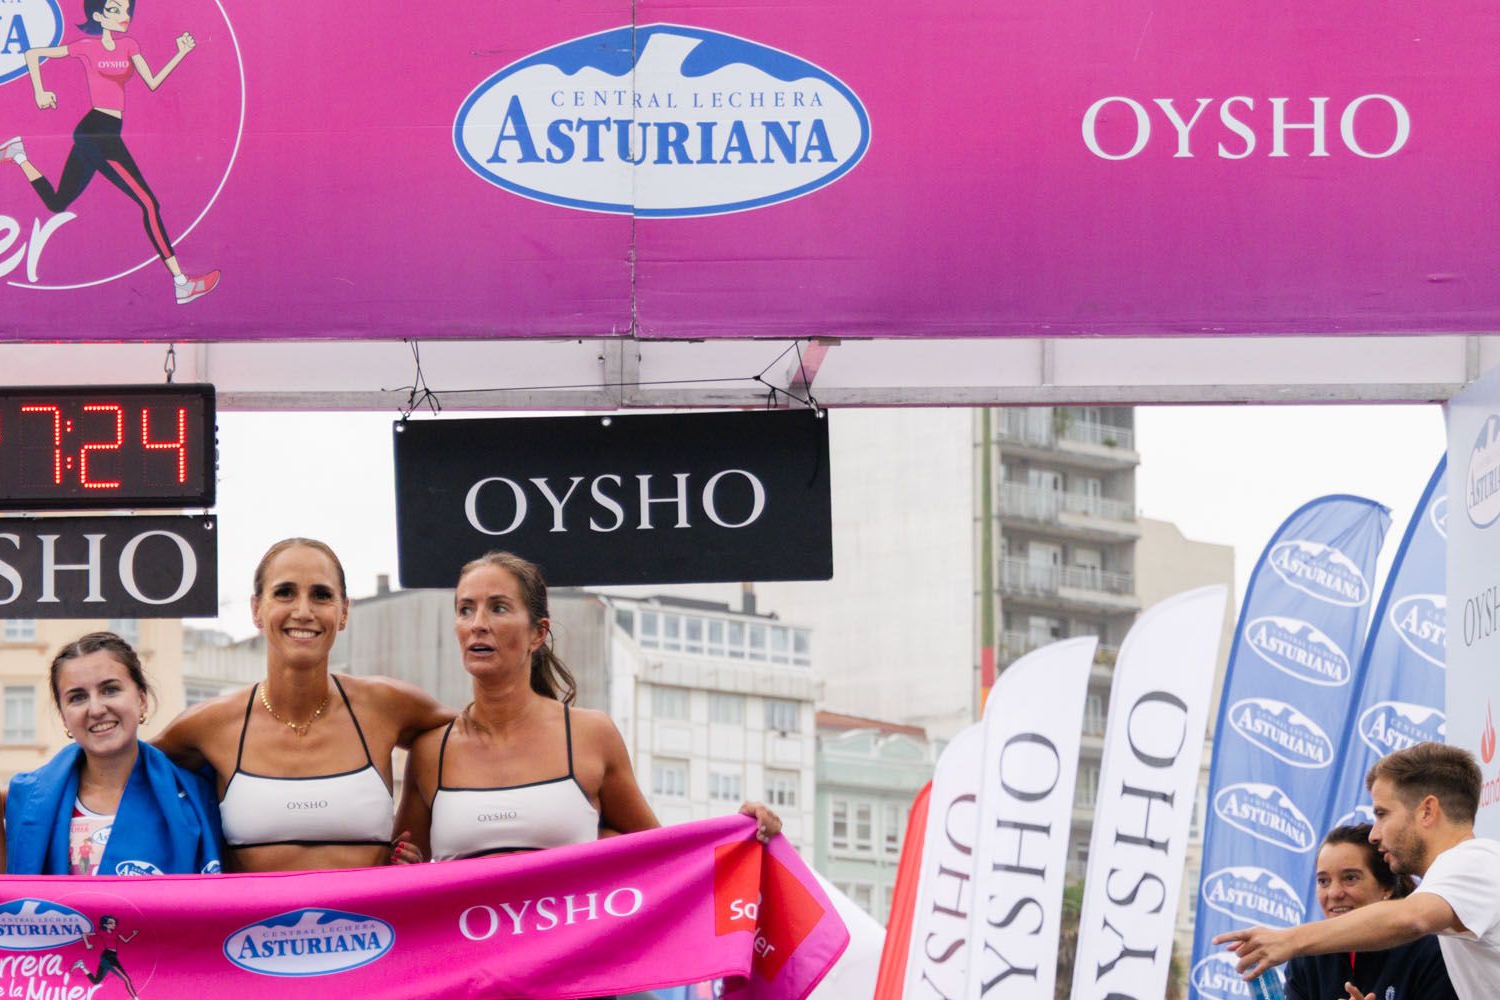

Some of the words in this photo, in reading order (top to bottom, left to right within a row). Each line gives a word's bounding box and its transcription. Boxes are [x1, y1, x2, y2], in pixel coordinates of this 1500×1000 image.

[98, 60, 129, 69] OYSHO
[551, 90, 678, 108] CENTRAL
[693, 91, 825, 109] LECHERA
[1081, 93, 1410, 160] OYSHO
[487, 94, 838, 165] ASTURIANA
[464, 469, 766, 536] OYSHO
[1463, 585, 1500, 647] OYSH
[1253, 624, 1342, 681] ASTURIANA
[1238, 706, 1325, 764] ASTURIANA
[287, 800, 328, 810] OYSHO
[477, 811, 518, 822] OYSHO
[1223, 791, 1307, 849] ASTURIANA
[262, 926, 314, 939] CENTRAL
[318, 921, 377, 935] LECHERA
[458, 886, 644, 942] OYSHO
[237, 931, 382, 961] ASTURIANA
[8, 978, 24, 998] la
